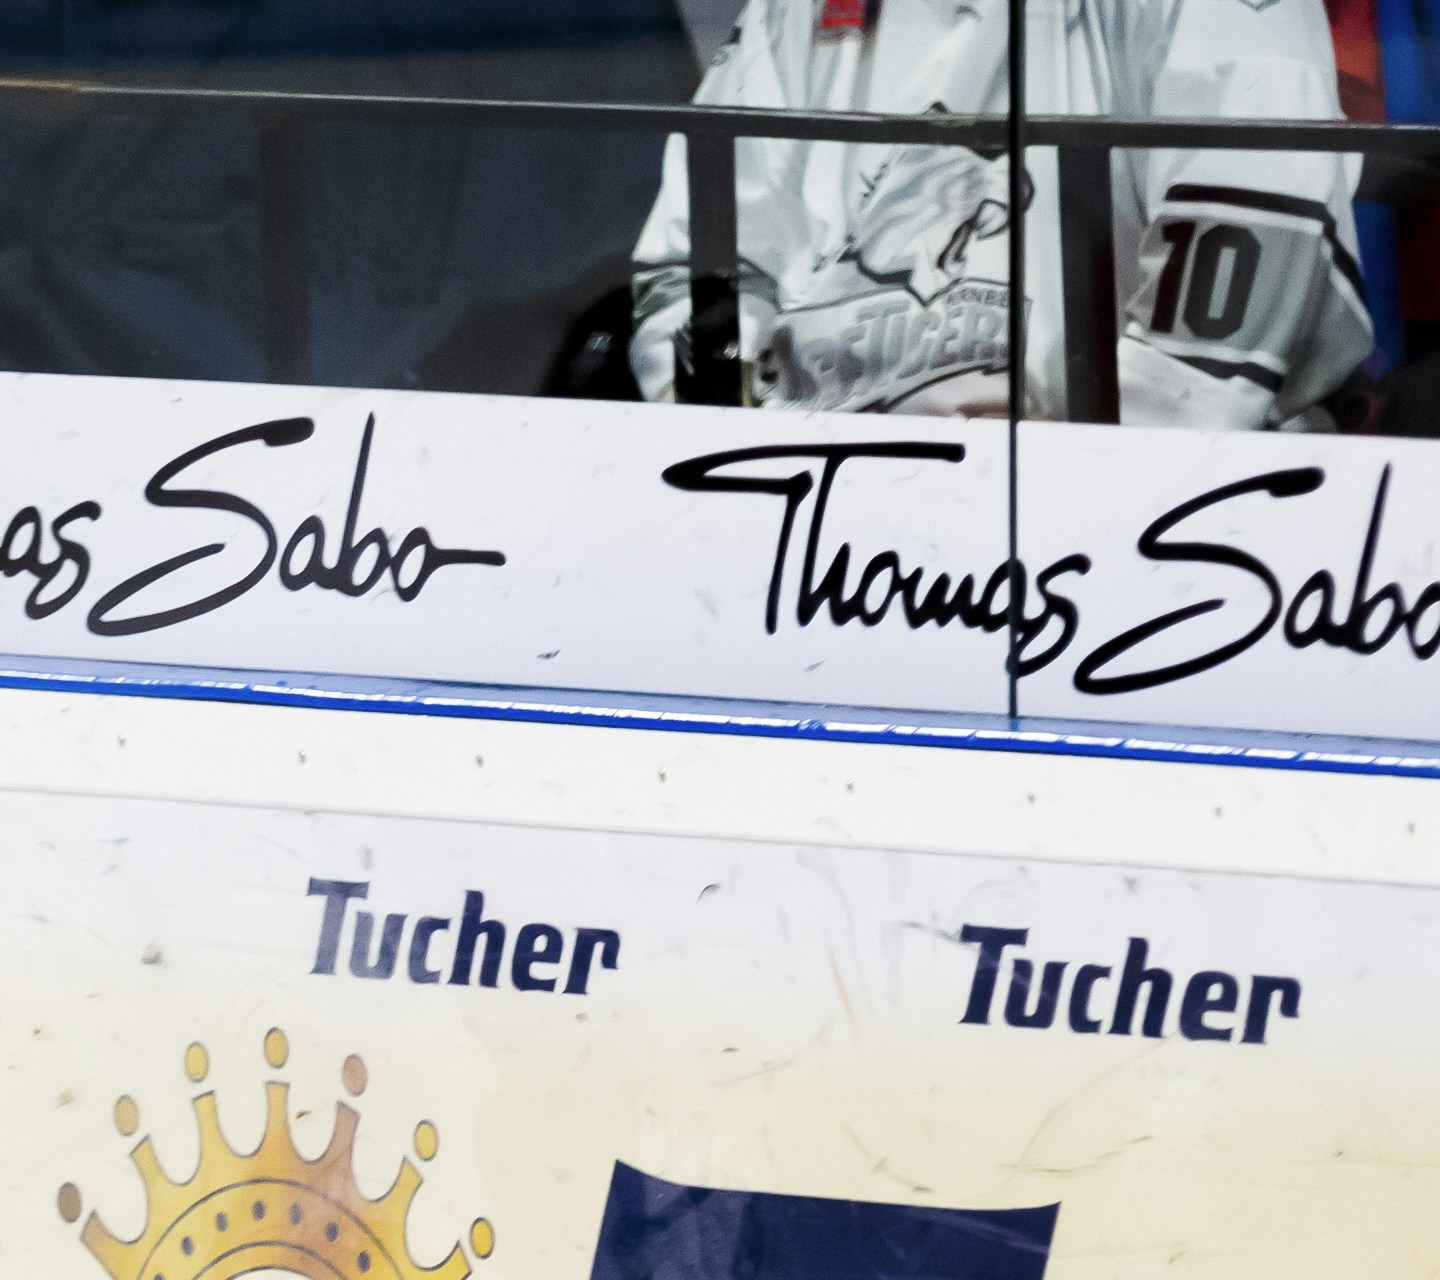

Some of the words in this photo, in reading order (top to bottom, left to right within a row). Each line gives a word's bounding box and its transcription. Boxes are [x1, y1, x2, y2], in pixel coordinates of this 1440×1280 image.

[1150, 220, 1262, 341] 10
[87, 412, 506, 637] Sabo
[661, 441, 1091, 679] Thomas
[306, 877, 621, 996] Tucher
[958, 922, 1302, 1046] Tucher
